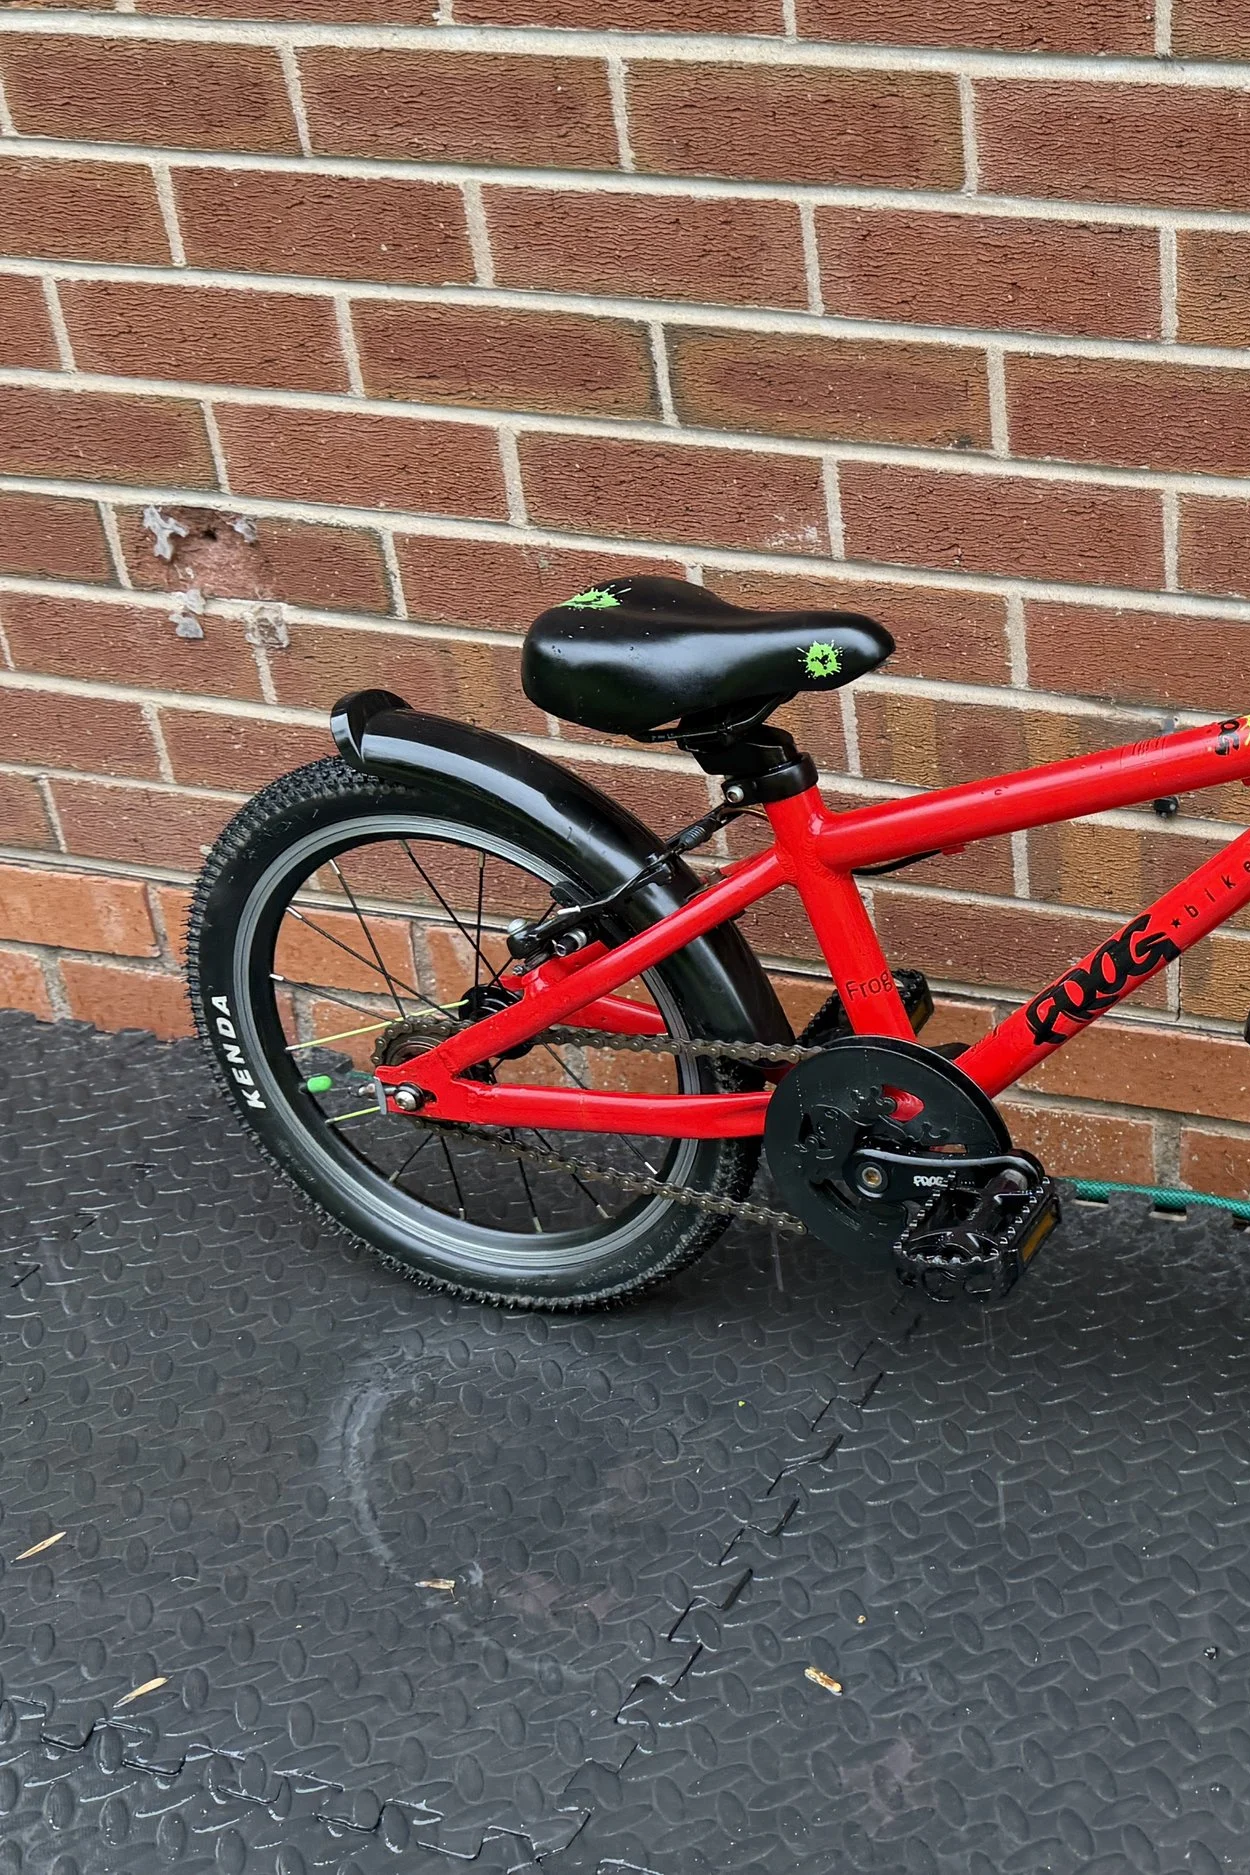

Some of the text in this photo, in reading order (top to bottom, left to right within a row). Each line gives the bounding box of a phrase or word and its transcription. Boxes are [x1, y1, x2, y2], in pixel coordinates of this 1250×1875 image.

[845, 970, 893, 1001] Frog
[1025, 914, 1182, 1046] FROG
[211, 995, 267, 1109] KENDA
